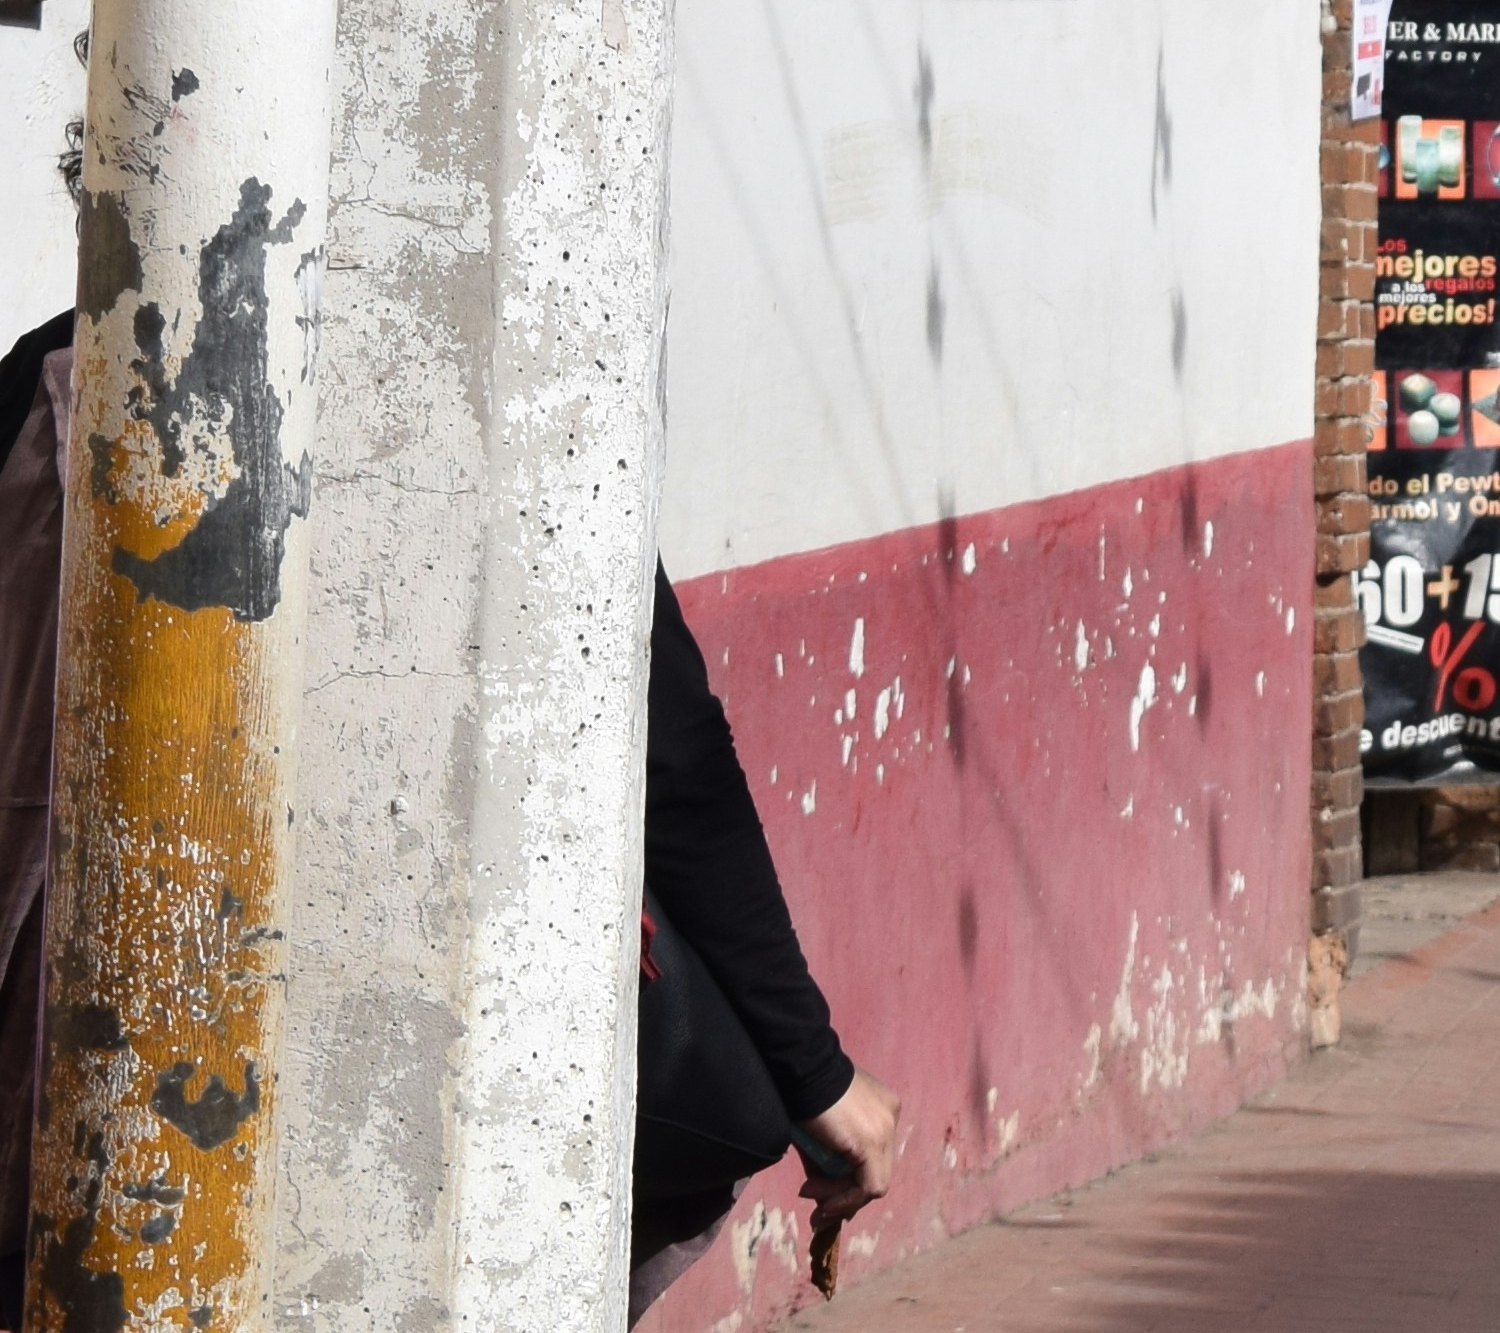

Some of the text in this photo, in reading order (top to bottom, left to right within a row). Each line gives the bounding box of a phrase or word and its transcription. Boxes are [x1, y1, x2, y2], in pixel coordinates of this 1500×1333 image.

[1389, 21, 1419, 41] ER
[1423, 22, 1441, 41] &
[1384, 50, 1482, 63] FACTORY
[1391, 281, 1425, 293] a los
[1425, 277, 1495, 294] regalos
[1378, 292, 1437, 305] mejores
[1377, 298, 1496, 331] precios!
[1368, 475, 1399, 495] do
[1406, 473, 1430, 494] el
[1370, 499, 1439, 520] armol
[1446, 501, 1461, 524] y
[1430, 620, 1497, 712] %
[1358, 729, 1373, 753] e
